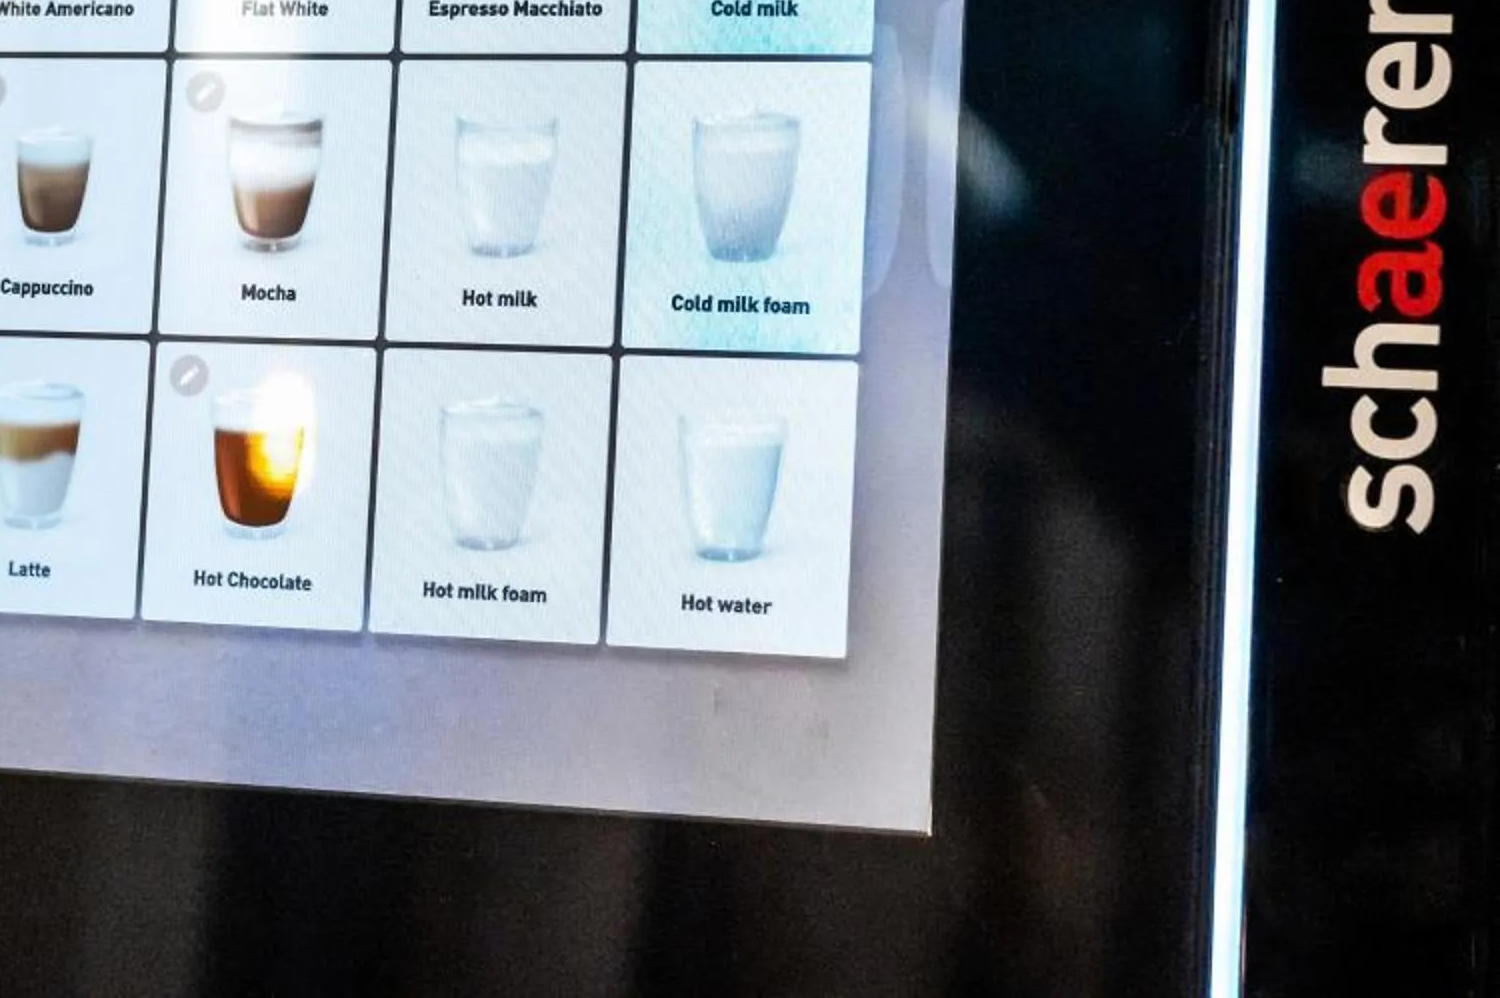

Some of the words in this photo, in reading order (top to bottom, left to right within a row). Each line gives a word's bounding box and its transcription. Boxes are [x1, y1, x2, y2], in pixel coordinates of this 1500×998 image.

[44, 0, 135, 17] Americano
[242, 0, 275, 17] Flat
[280, 0, 329, 17] White
[428, 0, 509, 21] Espresso
[514, 0, 603, 17] Macchiato
[710, 0, 753, 17] Cold
[757, 0, 799, 18] milk
[0, 278, 95, 299] Cappuccino
[241, 284, 297, 302] Mocha
[462, 289, 493, 307] Hot
[498, 289, 538, 309] milk
[671, 294, 713, 313] Cold
[718, 295, 759, 314] milk
[763, 296, 811, 315] foam
[8, 560, 51, 579] Latte
[194, 570, 223, 587] Hot
[227, 571, 313, 592] Chocolate
[423, 582, 453, 599] Hot
[458, 583, 498, 601] milk
[502, 584, 548, 604] foam
[681, 594, 713, 613] Hot
[717, 597, 773, 616] water
